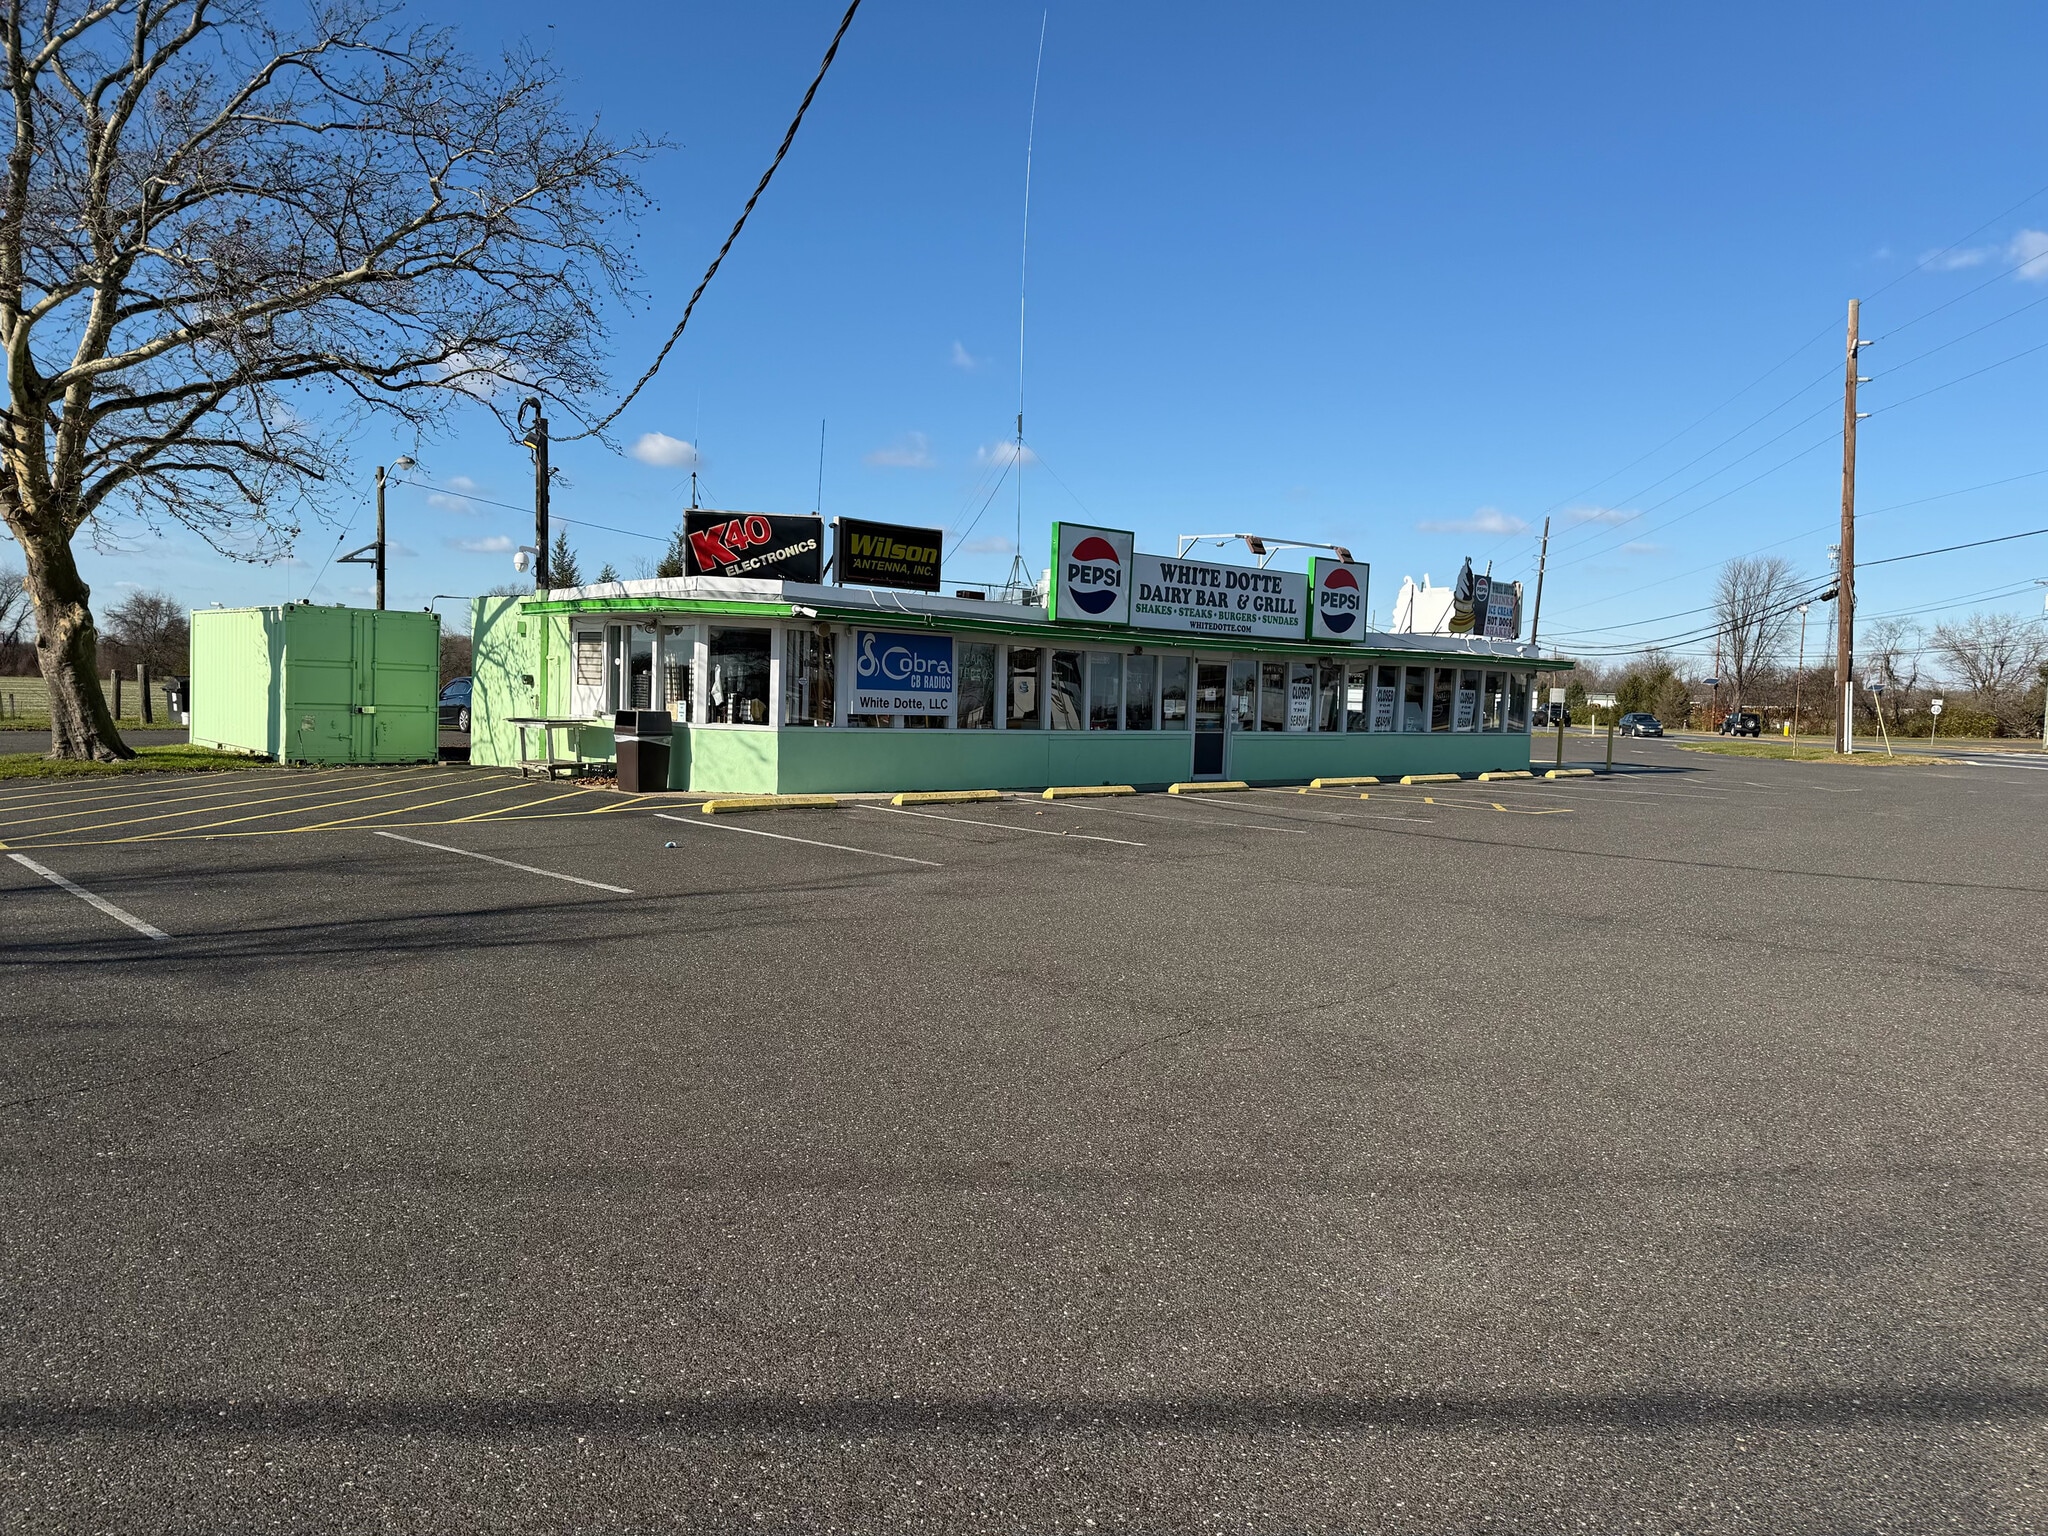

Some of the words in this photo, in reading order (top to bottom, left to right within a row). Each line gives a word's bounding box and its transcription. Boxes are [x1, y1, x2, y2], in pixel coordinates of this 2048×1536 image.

[688, 515, 772, 572] K40
[851, 533, 937, 564] Wilson
[725, 538, 817, 577] ELECTRONICS
[853, 558, 911, 575] ANTENNA,
[913, 565, 934, 577] INC.
[1068, 563, 1121, 588] PEPSI
[1160, 563, 1221, 588] WHITE
[1225, 572, 1282, 594] DOTTE
[1139, 583, 1192, 604] DAIRY
[1196, 591, 1229, 608] BAR
[1237, 594, 1250, 610] &
[1253, 596, 1297, 614] GRILL
[1321, 591, 1360, 611] PEPSI
[1490, 594, 1513, 606] DRINKS
[1135, 603, 1172, 616] SHAKES
[1178, 607, 1213, 619] STEAKS
[1218, 611, 1257, 623] BURGERS
[1262, 615, 1299, 626] SUNDAES
[1488, 605, 1496, 615] ICE
[1189, 620, 1252, 633] WHITEDOTTE.COM
[1487, 616, 1498, 626] HOT
[882, 646, 951, 680] Cobra
[910, 674, 921, 688] CB
[923, 675, 951, 690] RADIOS
[1292, 686, 1311, 700] CLOSED
[1377, 689, 1394, 702] CLOSED
[859, 696, 890, 709] White
[894, 697, 925, 711] Dotte,
[929, 698, 948, 710] LLC
[1290, 715, 1308, 727] SEASON
